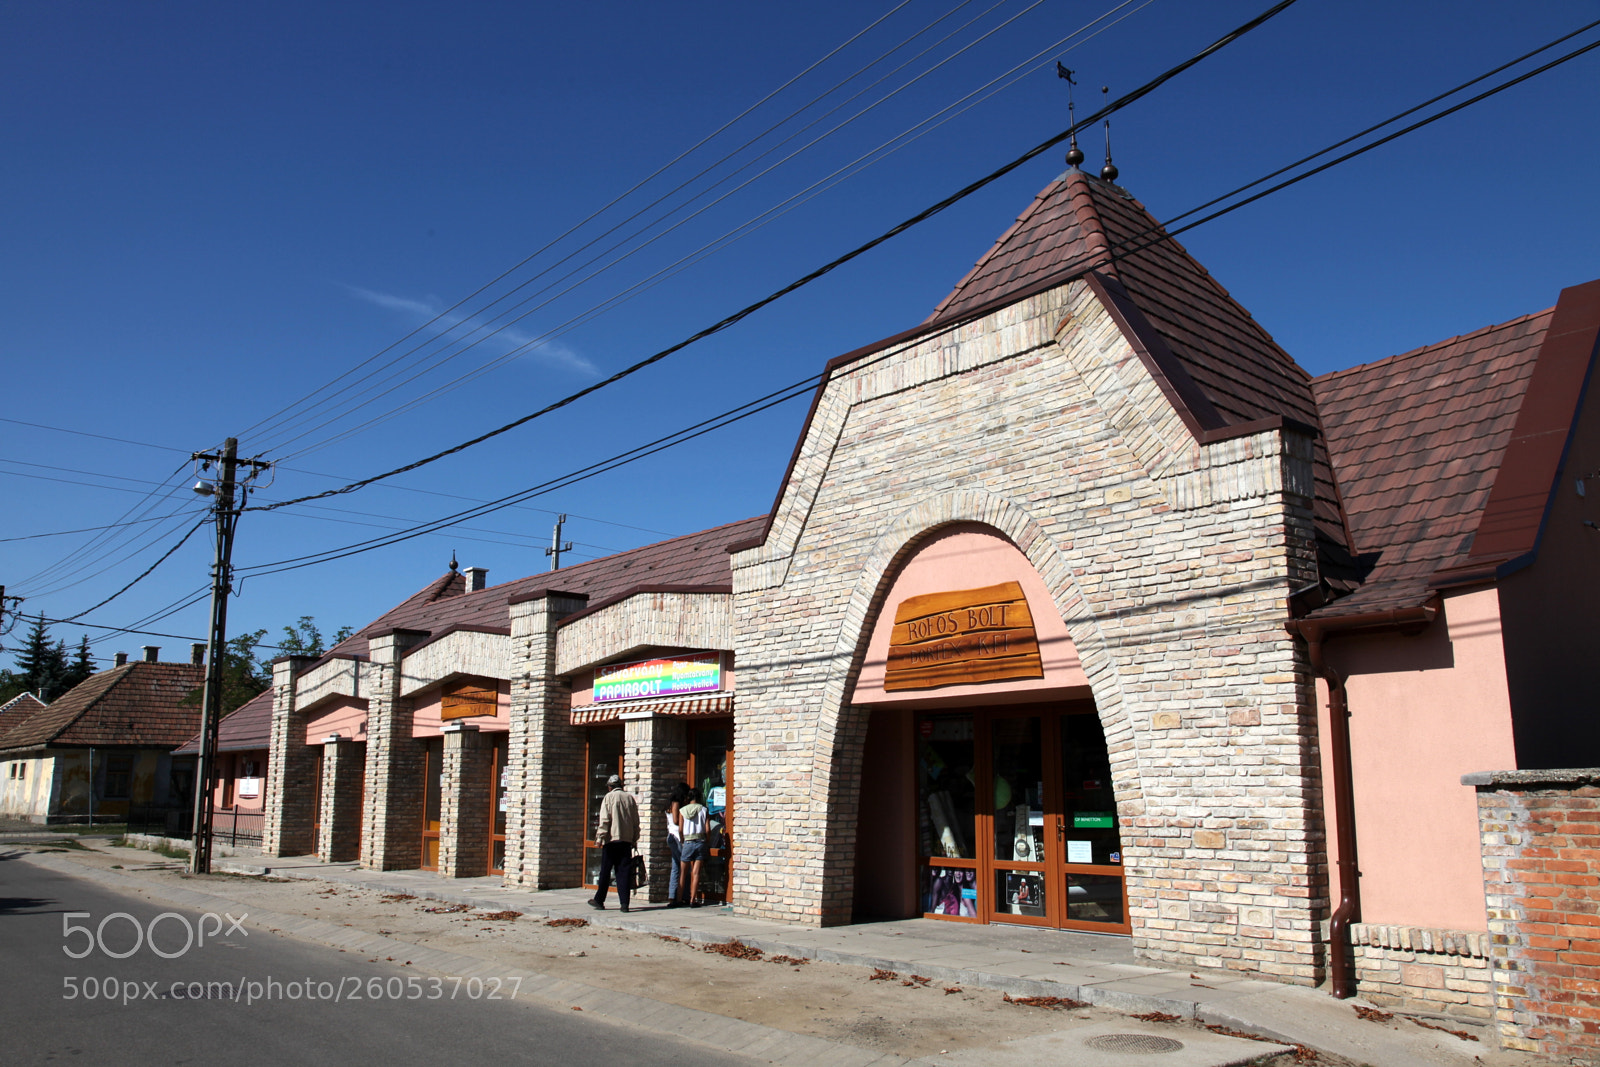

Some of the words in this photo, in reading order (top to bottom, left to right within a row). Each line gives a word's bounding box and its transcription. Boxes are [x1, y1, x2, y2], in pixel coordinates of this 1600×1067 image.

[968, 605, 1009, 629] BOLT
[978, 634, 1011, 655] KFT
[600, 679, 662, 700] PAPÍRBOLT
